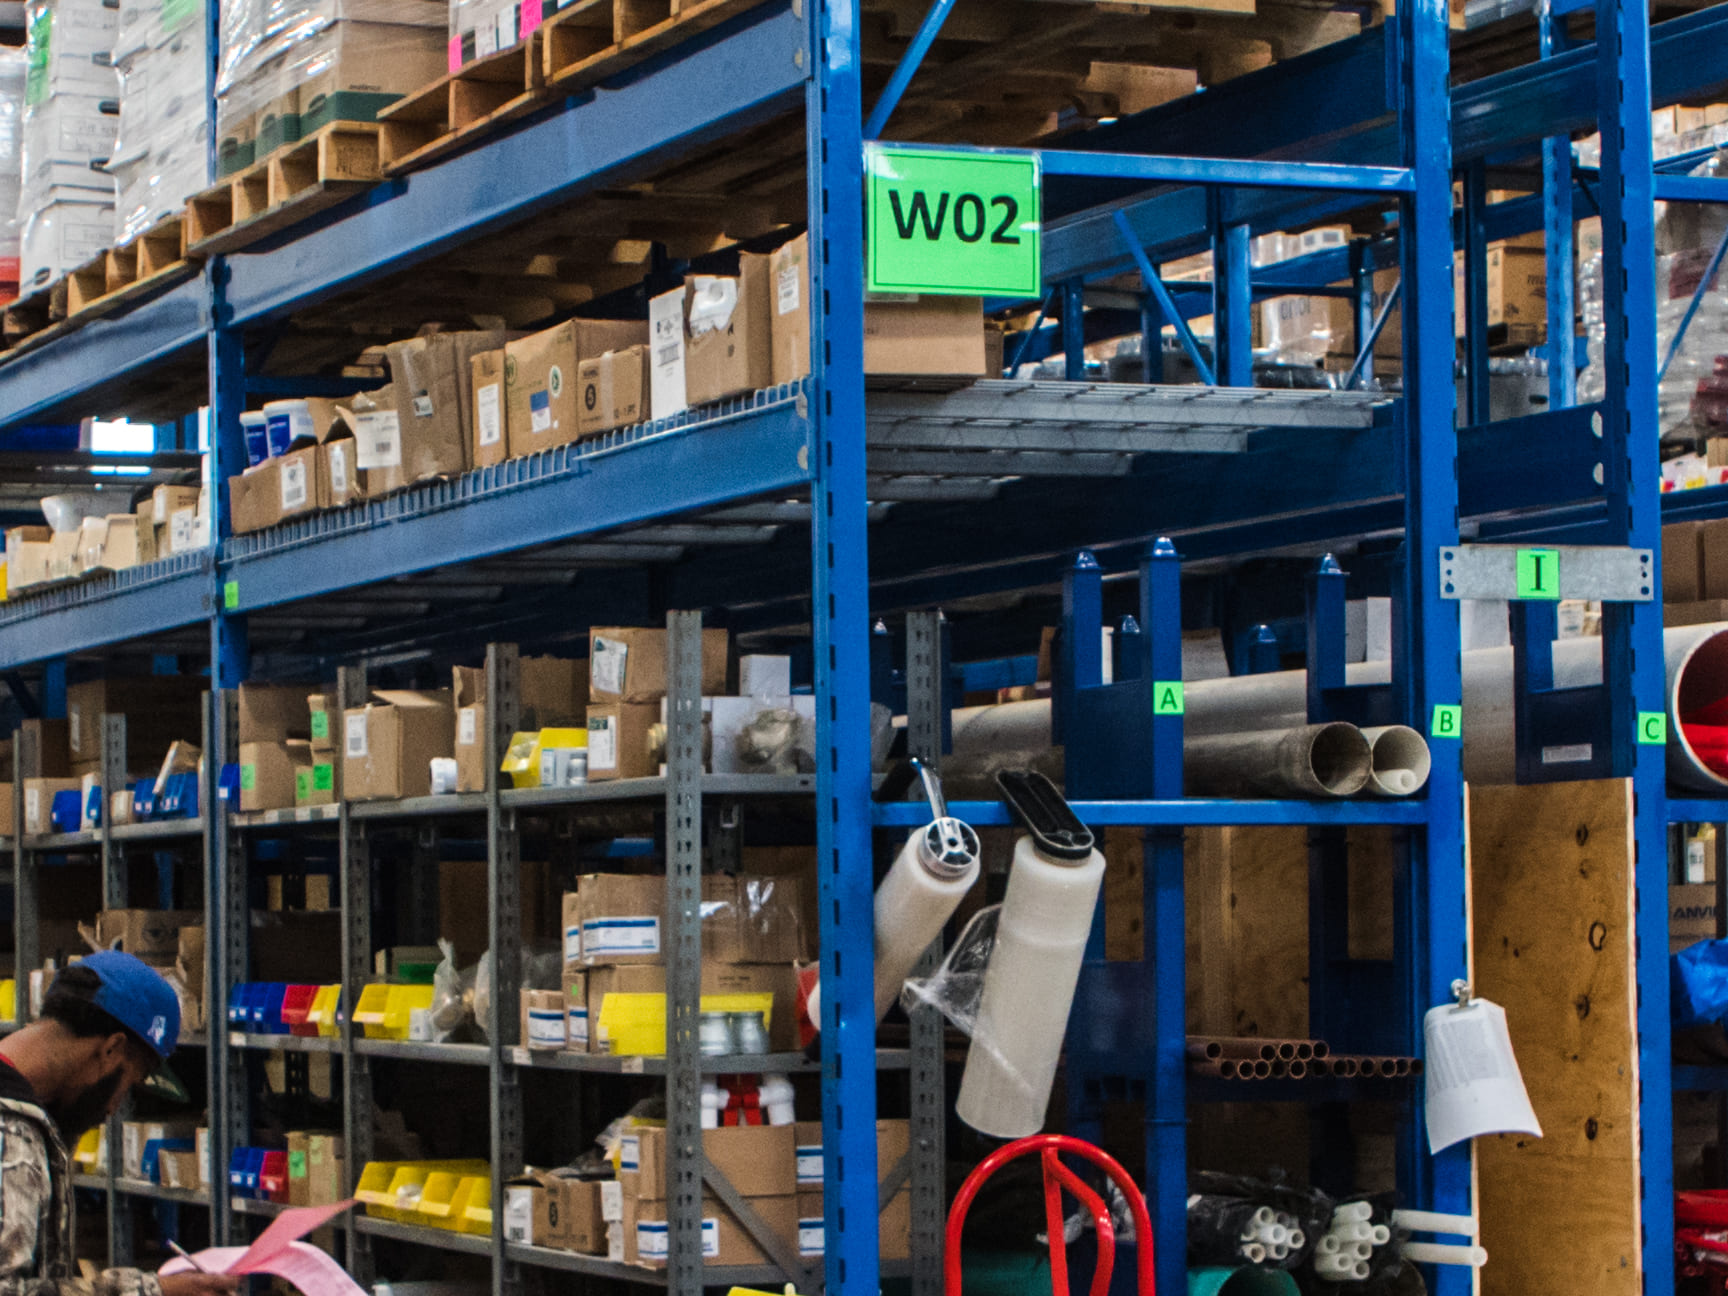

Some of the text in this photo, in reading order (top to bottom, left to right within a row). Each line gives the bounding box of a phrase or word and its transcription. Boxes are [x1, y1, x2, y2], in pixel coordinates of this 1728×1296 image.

[888, 189, 1021, 245] W02
[1530, 554, 1547, 592] I
[1160, 687, 1178, 710] A
[1439, 710, 1454, 733] B
[1645, 717, 1660, 740] C
